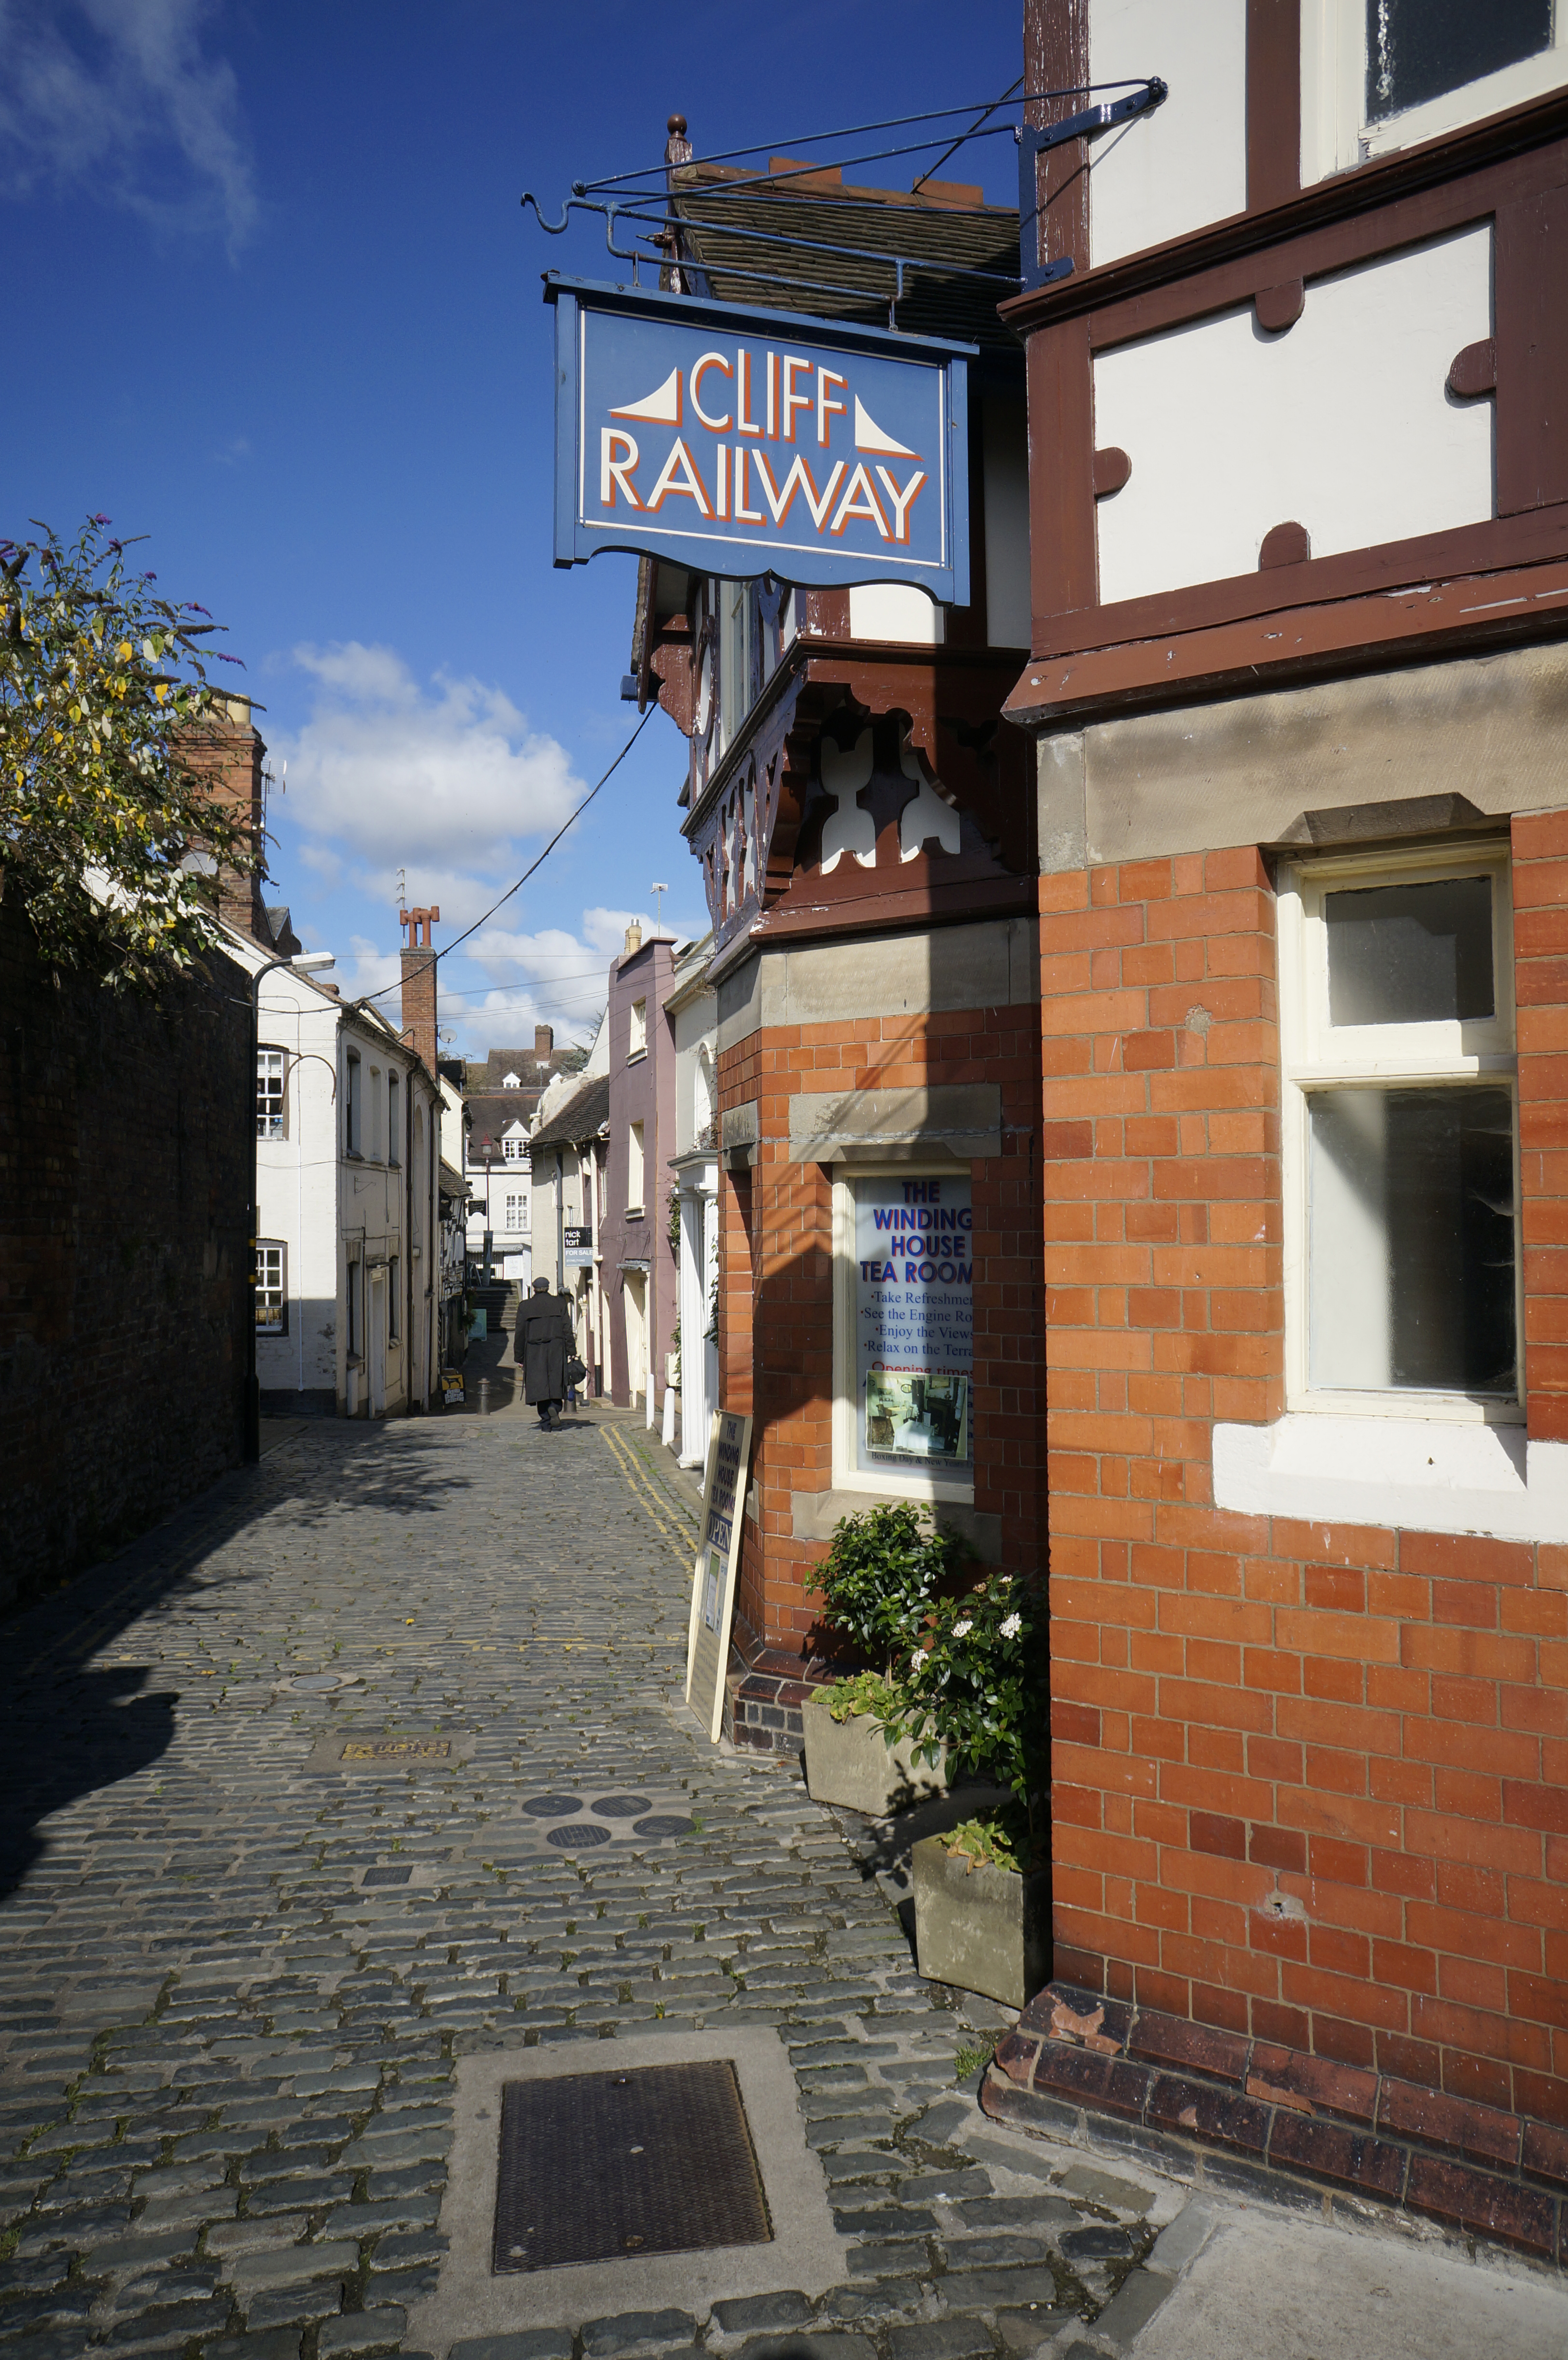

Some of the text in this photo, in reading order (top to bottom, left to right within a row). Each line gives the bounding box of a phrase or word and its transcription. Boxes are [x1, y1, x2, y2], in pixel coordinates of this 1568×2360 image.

[690, 349, 848, 448] CLIFF
[600, 427, 929, 545] RAILWAY
[902, 1181, 940, 1203] THE
[873, 1208, 972, 1231] WINDING
[892, 1235, 965, 1258] HOUSE
[860, 1261, 972, 1284] TEA ROOM
[874, 1291, 901, 1303] Take
[865, 1307, 884, 1319] See
[889, 1308, 906, 1320] the
[910, 1309, 951, 1324] Engine
[879, 1324, 913, 1340] Enjoy
[917, 1326, 934, 1338] the
[868, 1340, 900, 1352] Relax
[904, 1346, 918, 1354] on
[922, 1343, 940, 1355] the
[872, 1361, 931, 1373] Opening
[726, 1420, 737, 1440] THE
[718, 1441, 739, 1465] WINDING
[872, 1452, 896, 1462] Boxing
[899, 1454, 913, 1464] Day
[925, 1457, 942, 1465] New
[718, 1465, 734, 1488] HOUSE
[707, 1514, 732, 1551] OPEN
